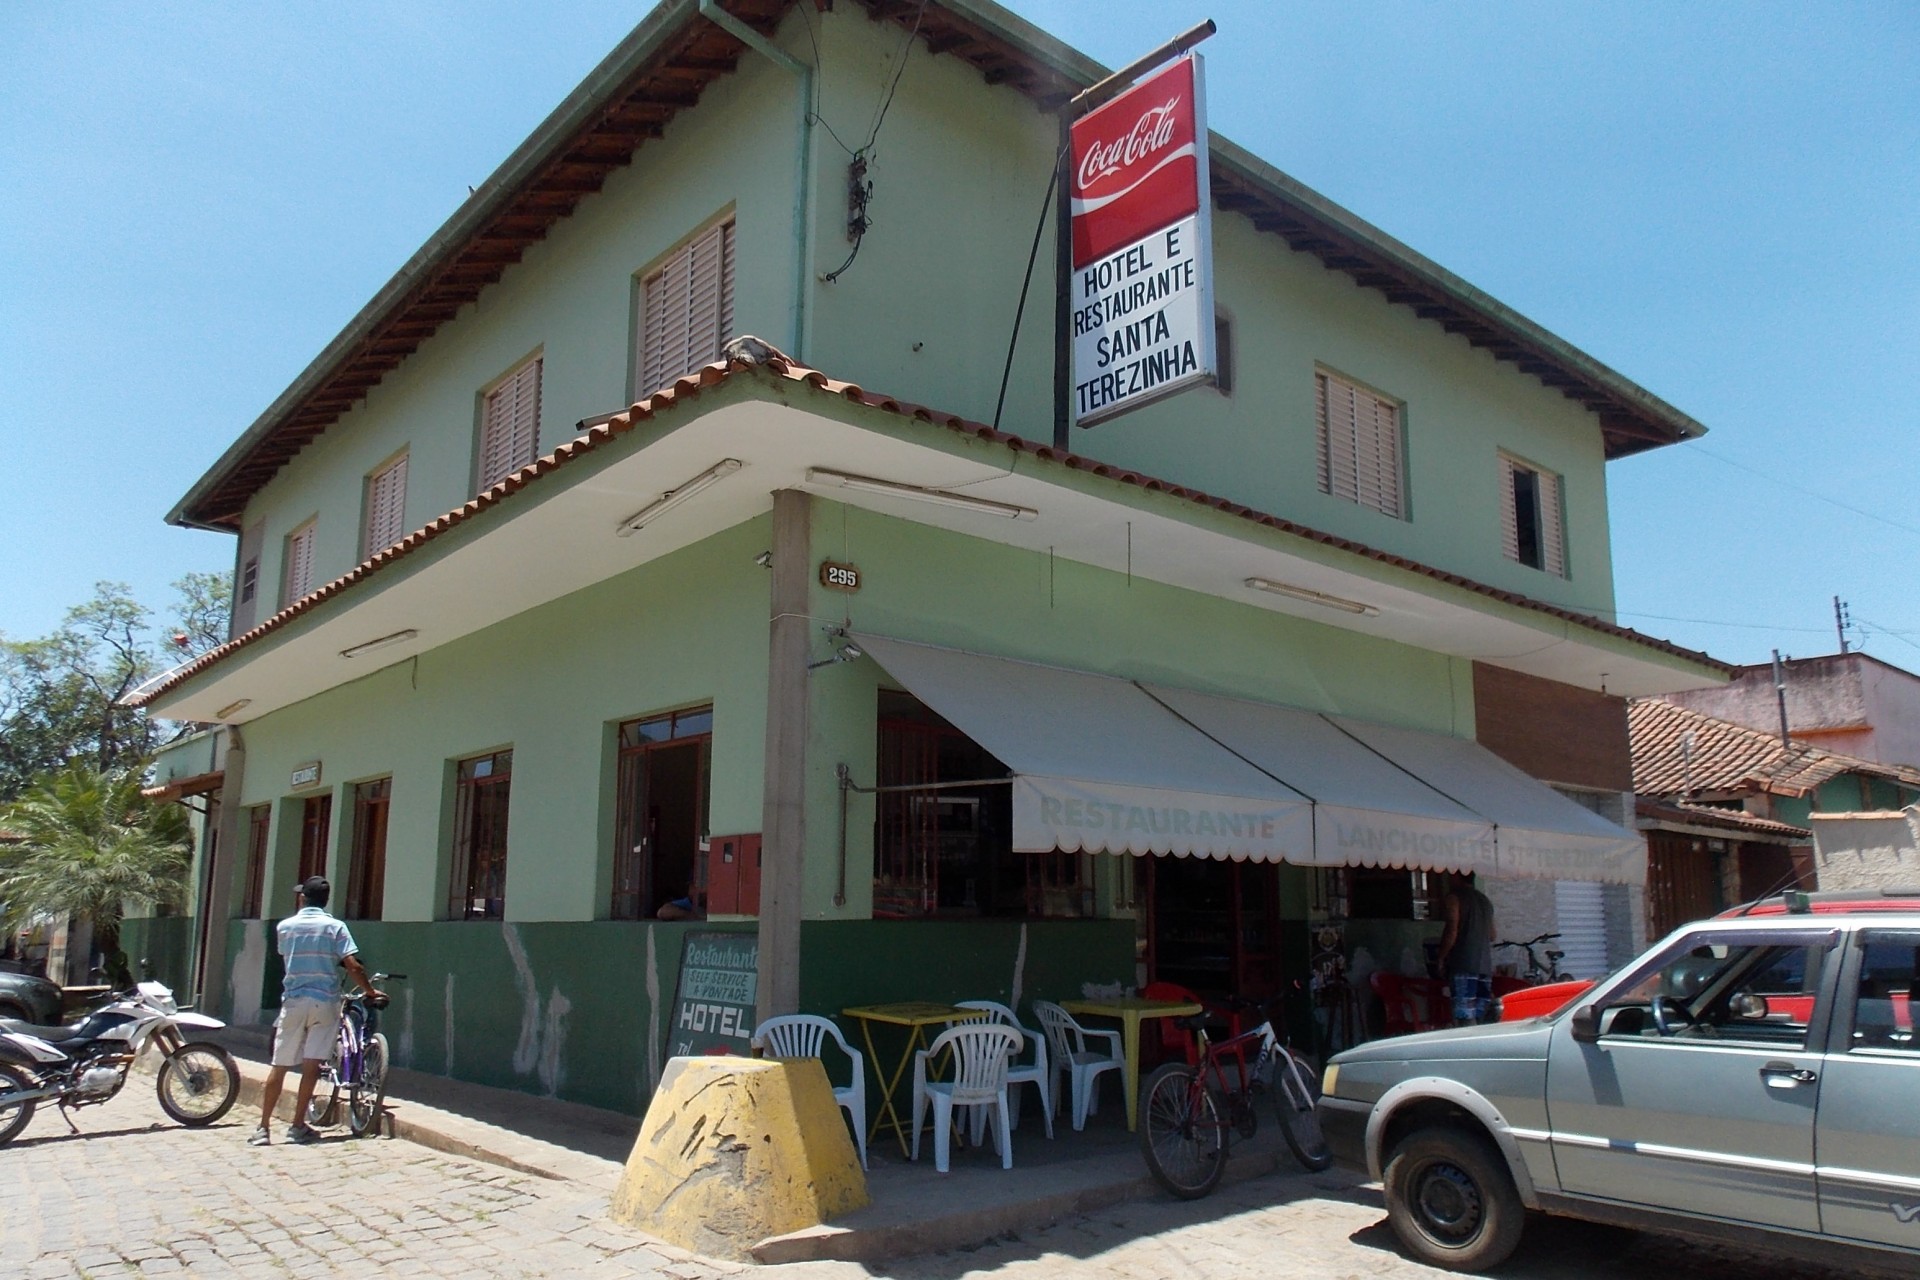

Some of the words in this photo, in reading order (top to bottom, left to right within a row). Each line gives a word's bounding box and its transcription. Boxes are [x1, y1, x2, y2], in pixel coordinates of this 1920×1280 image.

[1084, 244, 1153, 298] HOTEL
[1166, 227, 1180, 259] E
[1074, 258, 1194, 337] RESTAURANTE
[1096, 309, 1170, 368] SANTA
[1076, 340, 1197, 413] TEREZINHA
[829, 567, 856, 586] 295
[1040, 797, 1275, 839] RESTAURANTE
[1336, 823, 1491, 860] LANCHONETE
[690, 970, 709, 983] SELF
[712, 971, 748, 987] SERVICE
[702, 986, 748, 1001] VONTADE
[680, 1002, 750, 1038] HOTEL
